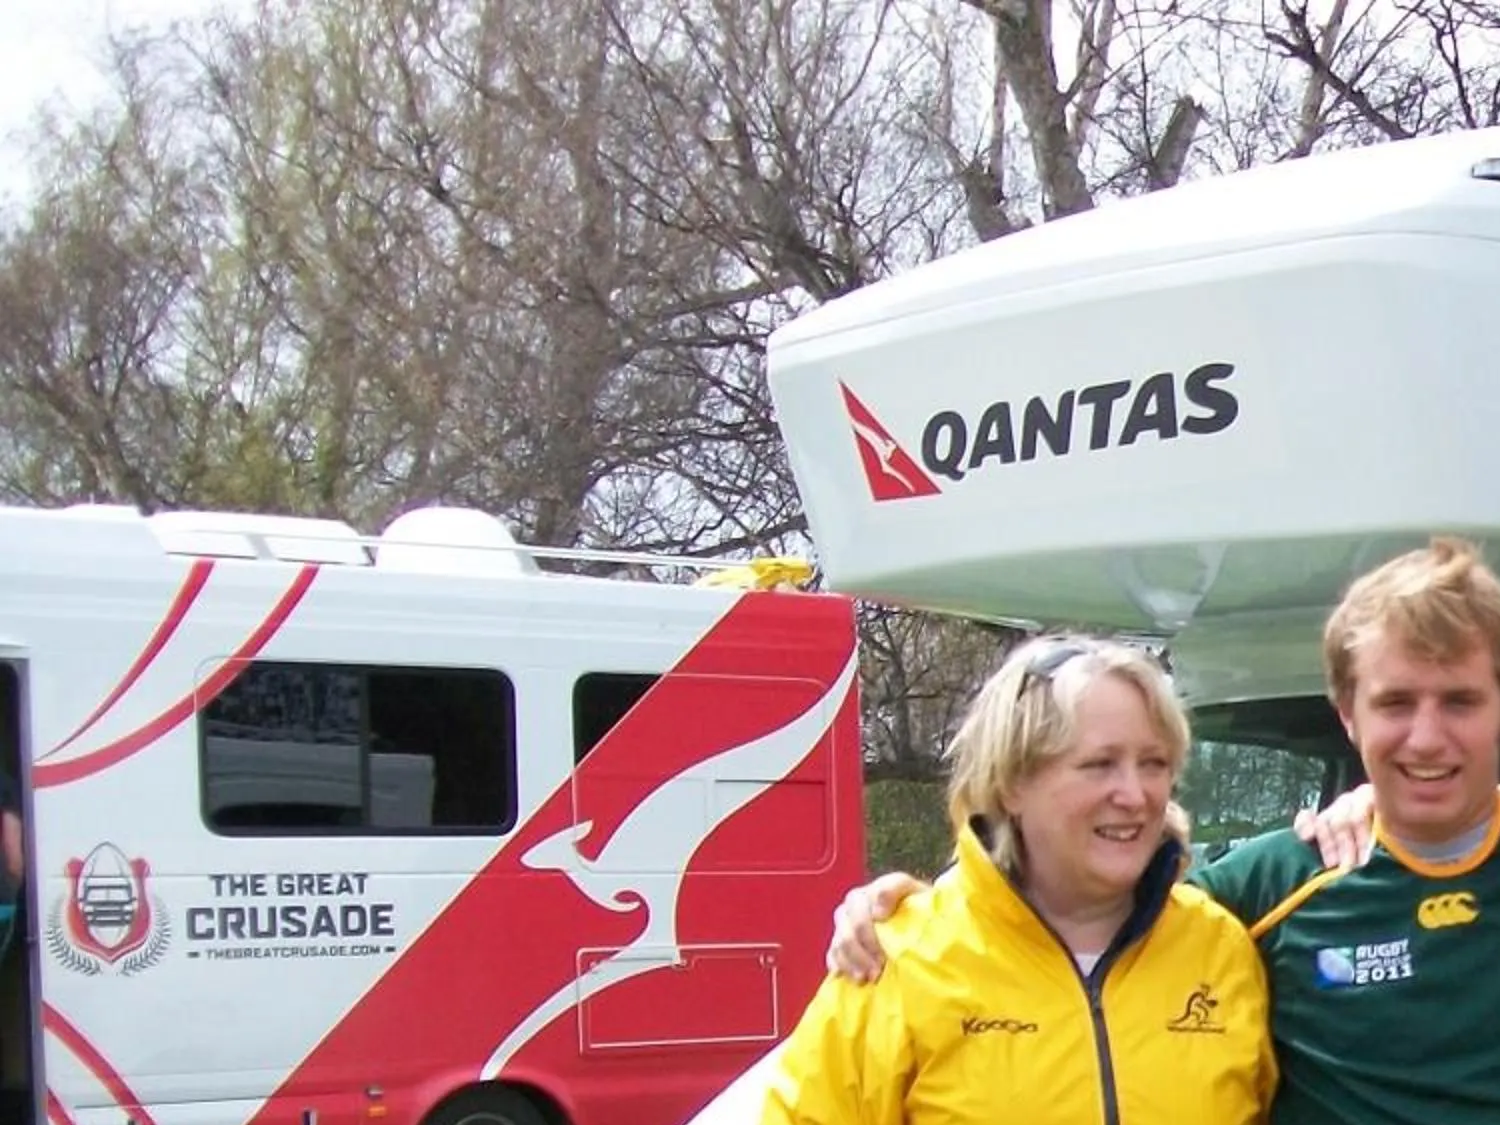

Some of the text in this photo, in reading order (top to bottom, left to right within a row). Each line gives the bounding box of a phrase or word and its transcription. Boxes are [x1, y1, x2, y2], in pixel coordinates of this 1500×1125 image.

[921, 362, 1239, 481] QANTAS
[209, 873, 369, 897] THE GREAT
[186, 903, 395, 940] CRUSADE
[206, 945, 381, 961] THEGREATCRUSADE.COM
[1355, 939, 1409, 961] RUGBY
[1355, 963, 1413, 985] 2011
